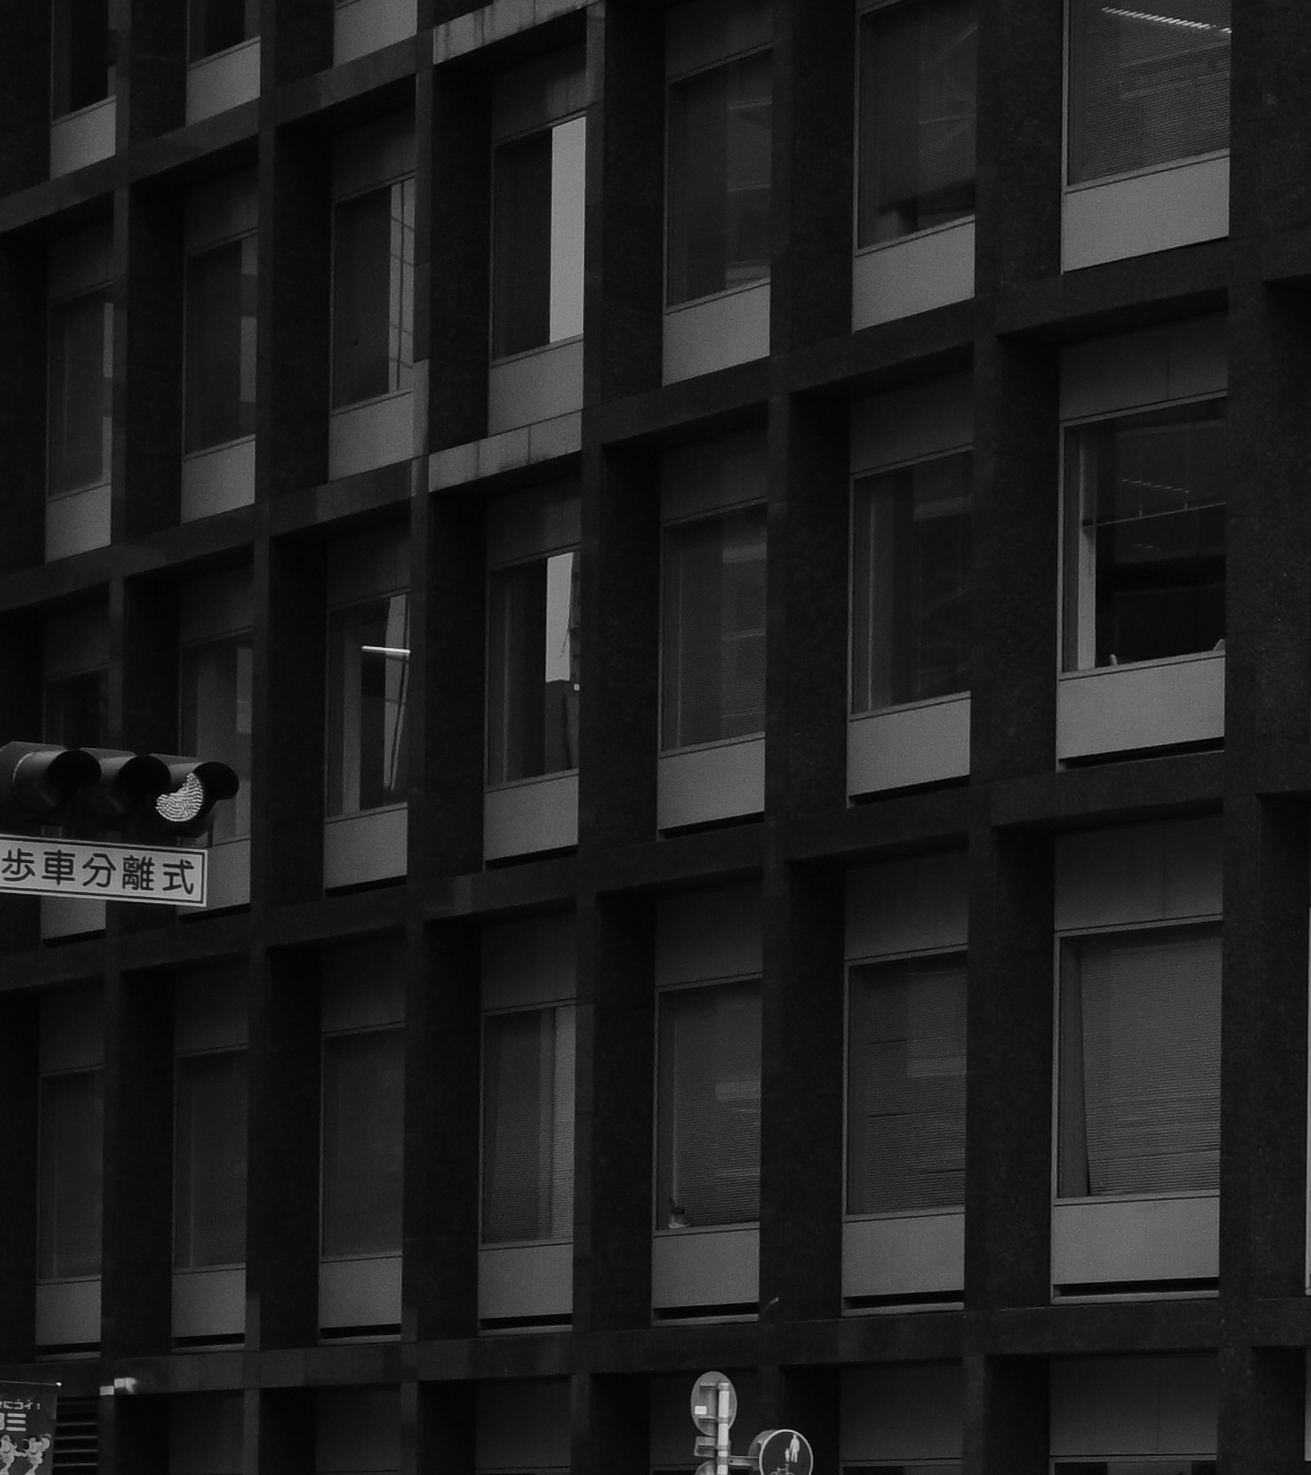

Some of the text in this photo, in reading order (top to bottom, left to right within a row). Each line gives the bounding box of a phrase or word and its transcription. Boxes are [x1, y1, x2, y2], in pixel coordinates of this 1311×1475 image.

[1, 848, 195, 895] 歩車分離式
